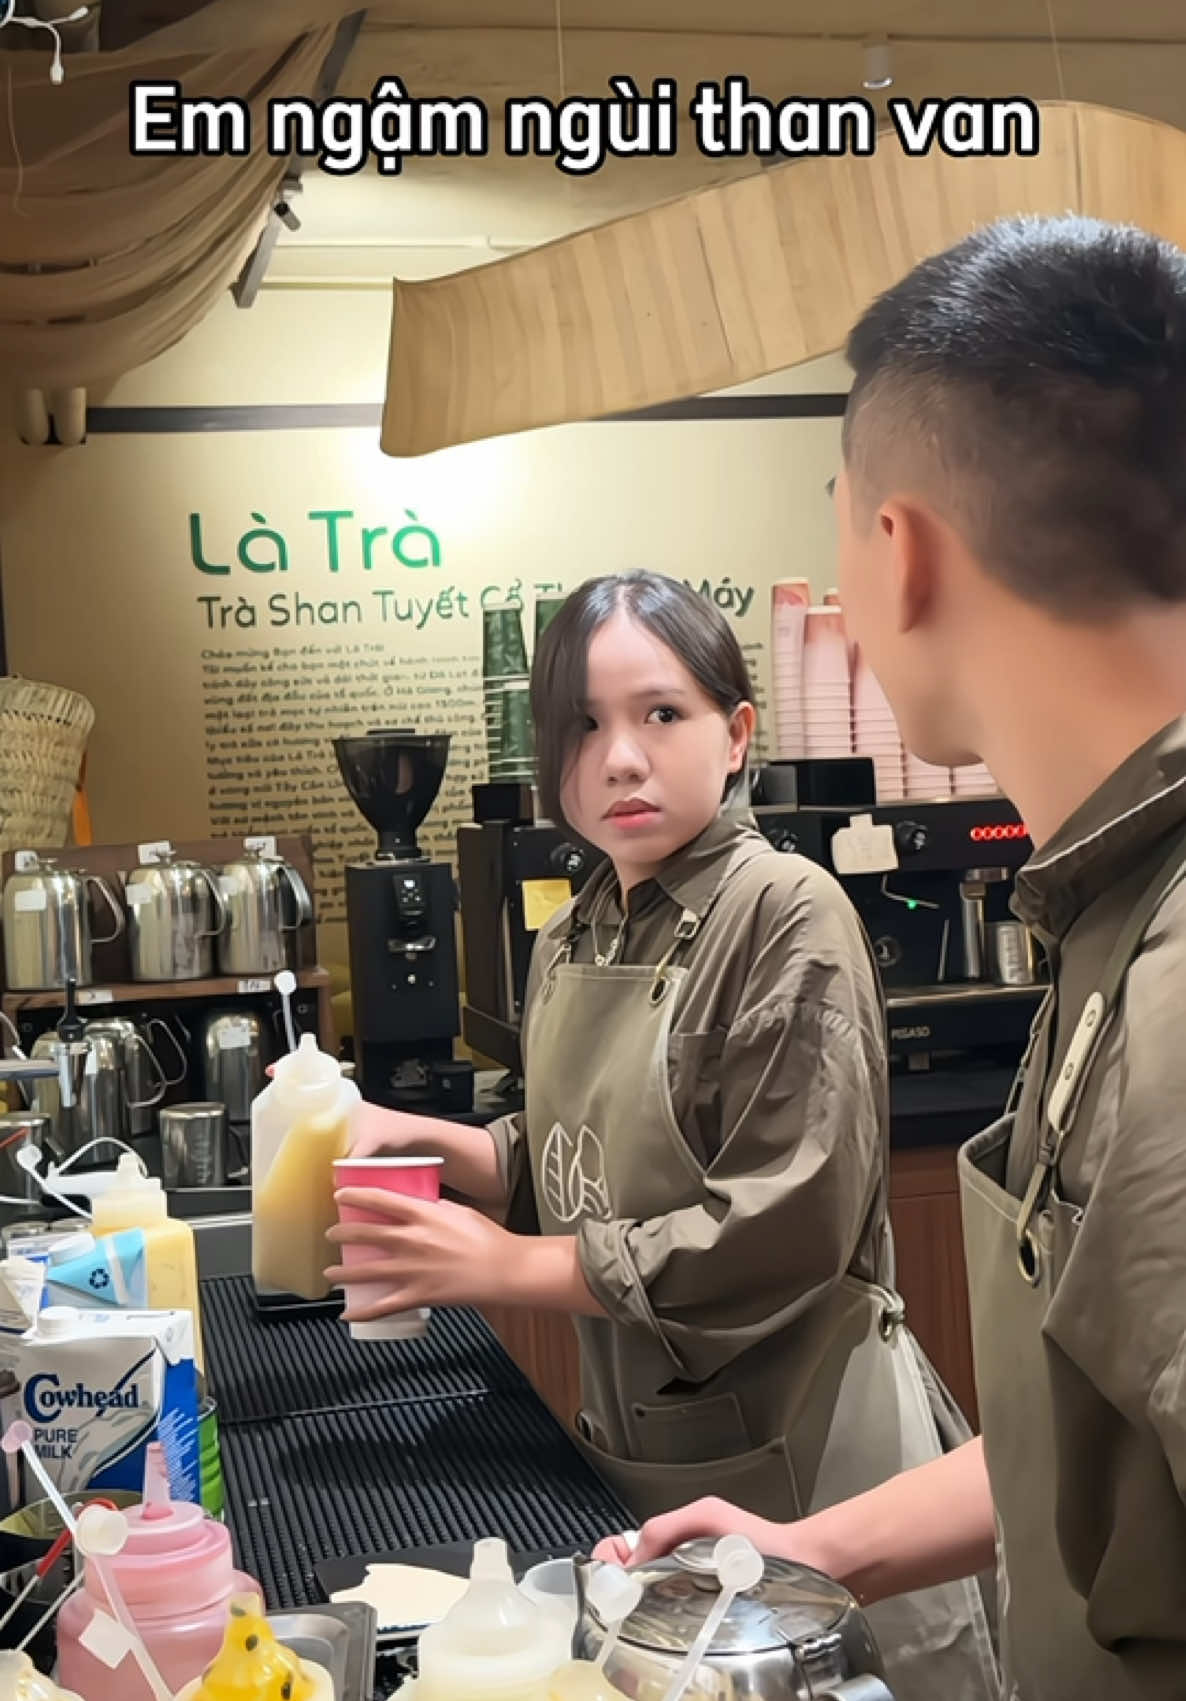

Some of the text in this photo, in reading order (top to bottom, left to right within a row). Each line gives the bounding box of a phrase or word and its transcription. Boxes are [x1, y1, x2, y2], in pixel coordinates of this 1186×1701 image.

[189, 508, 441, 575] Là Trà
[196, 596, 257, 630] Trà
[268, 592, 362, 627] Shan
[372, 585, 470, 630] Tuyết
[23, 1373, 139, 1423] Cowhead
[33, 1428, 78, 1444] PURE
[33, 1444, 74, 1460] MILK
